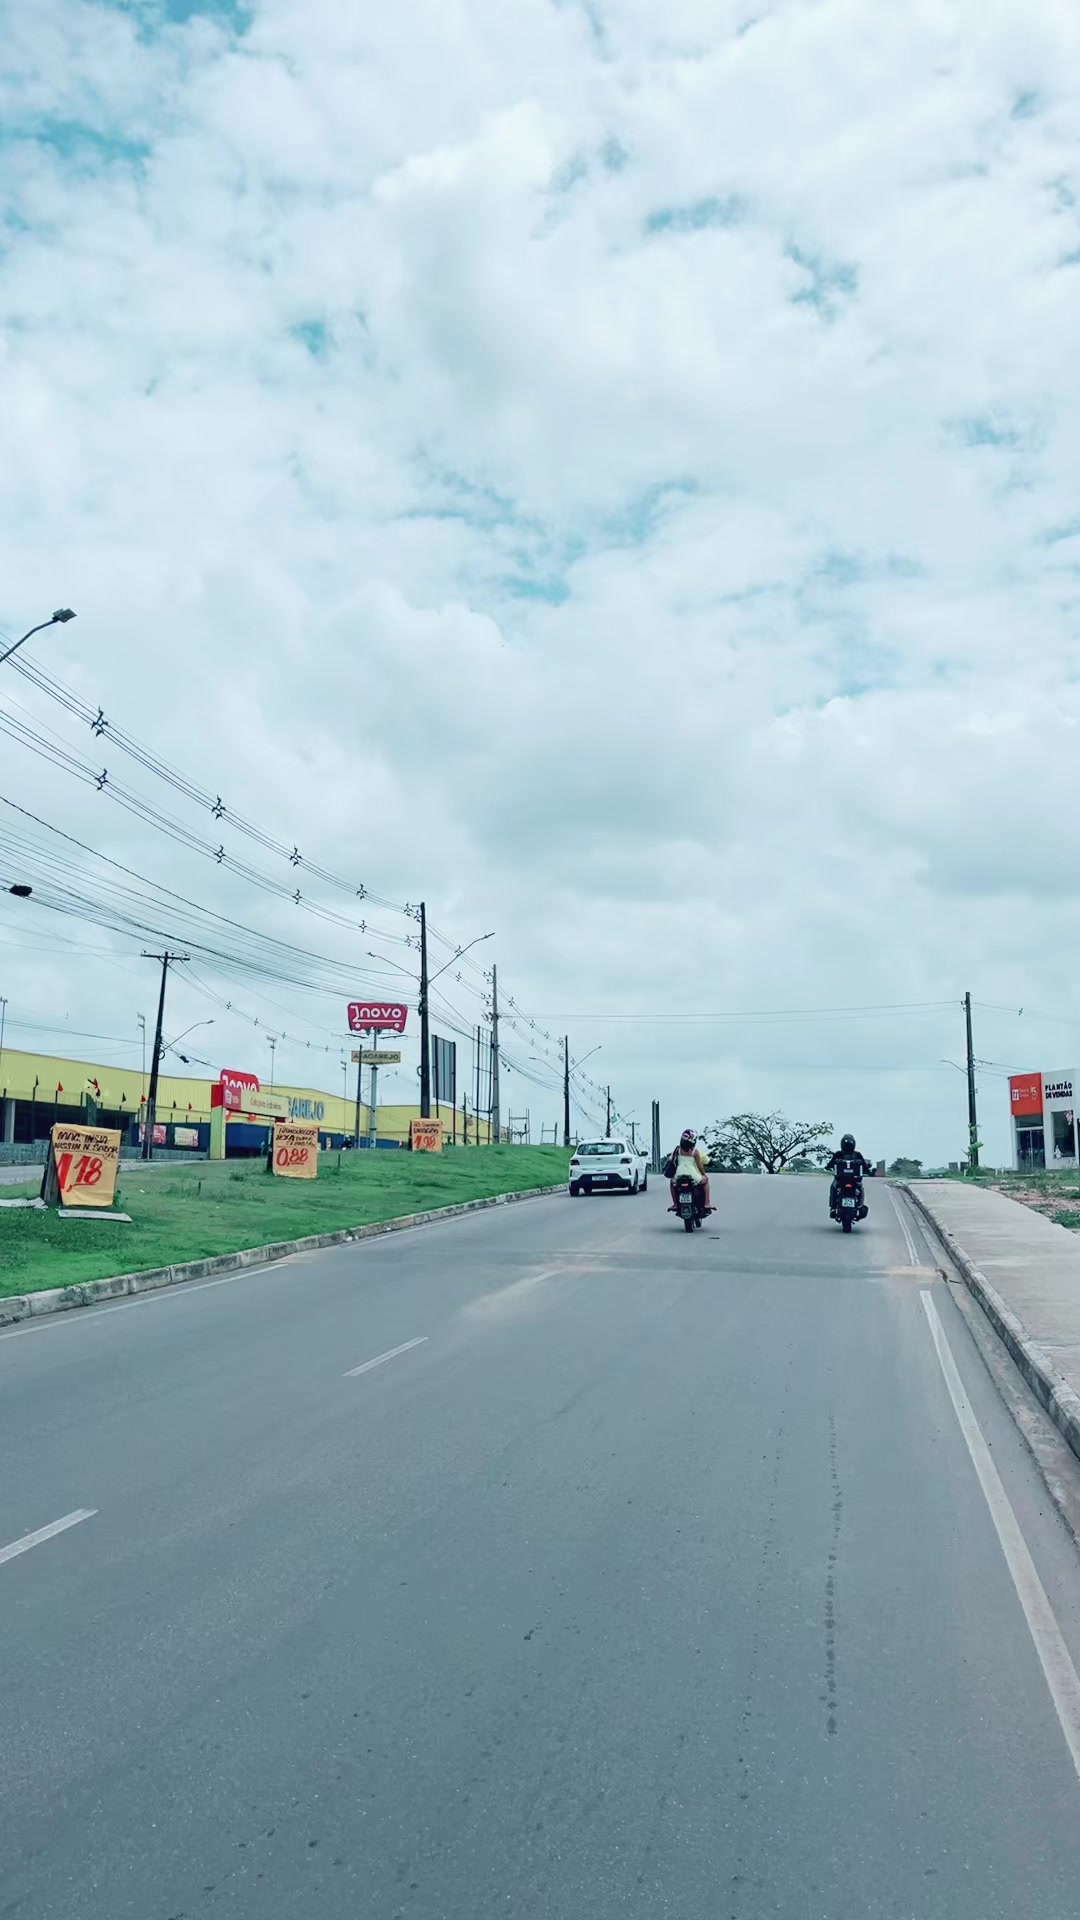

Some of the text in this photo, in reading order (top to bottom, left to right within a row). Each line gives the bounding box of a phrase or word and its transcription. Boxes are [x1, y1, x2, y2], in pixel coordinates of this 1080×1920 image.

[360, 1007, 402, 1018] novo
[353, 1052, 399, 1060] AACAREJO
[1045, 1081, 1072, 1091] PLANTÃO
[276, 1147, 309, 1166] 0,88
[57, 1153, 103, 1192] 1,18
